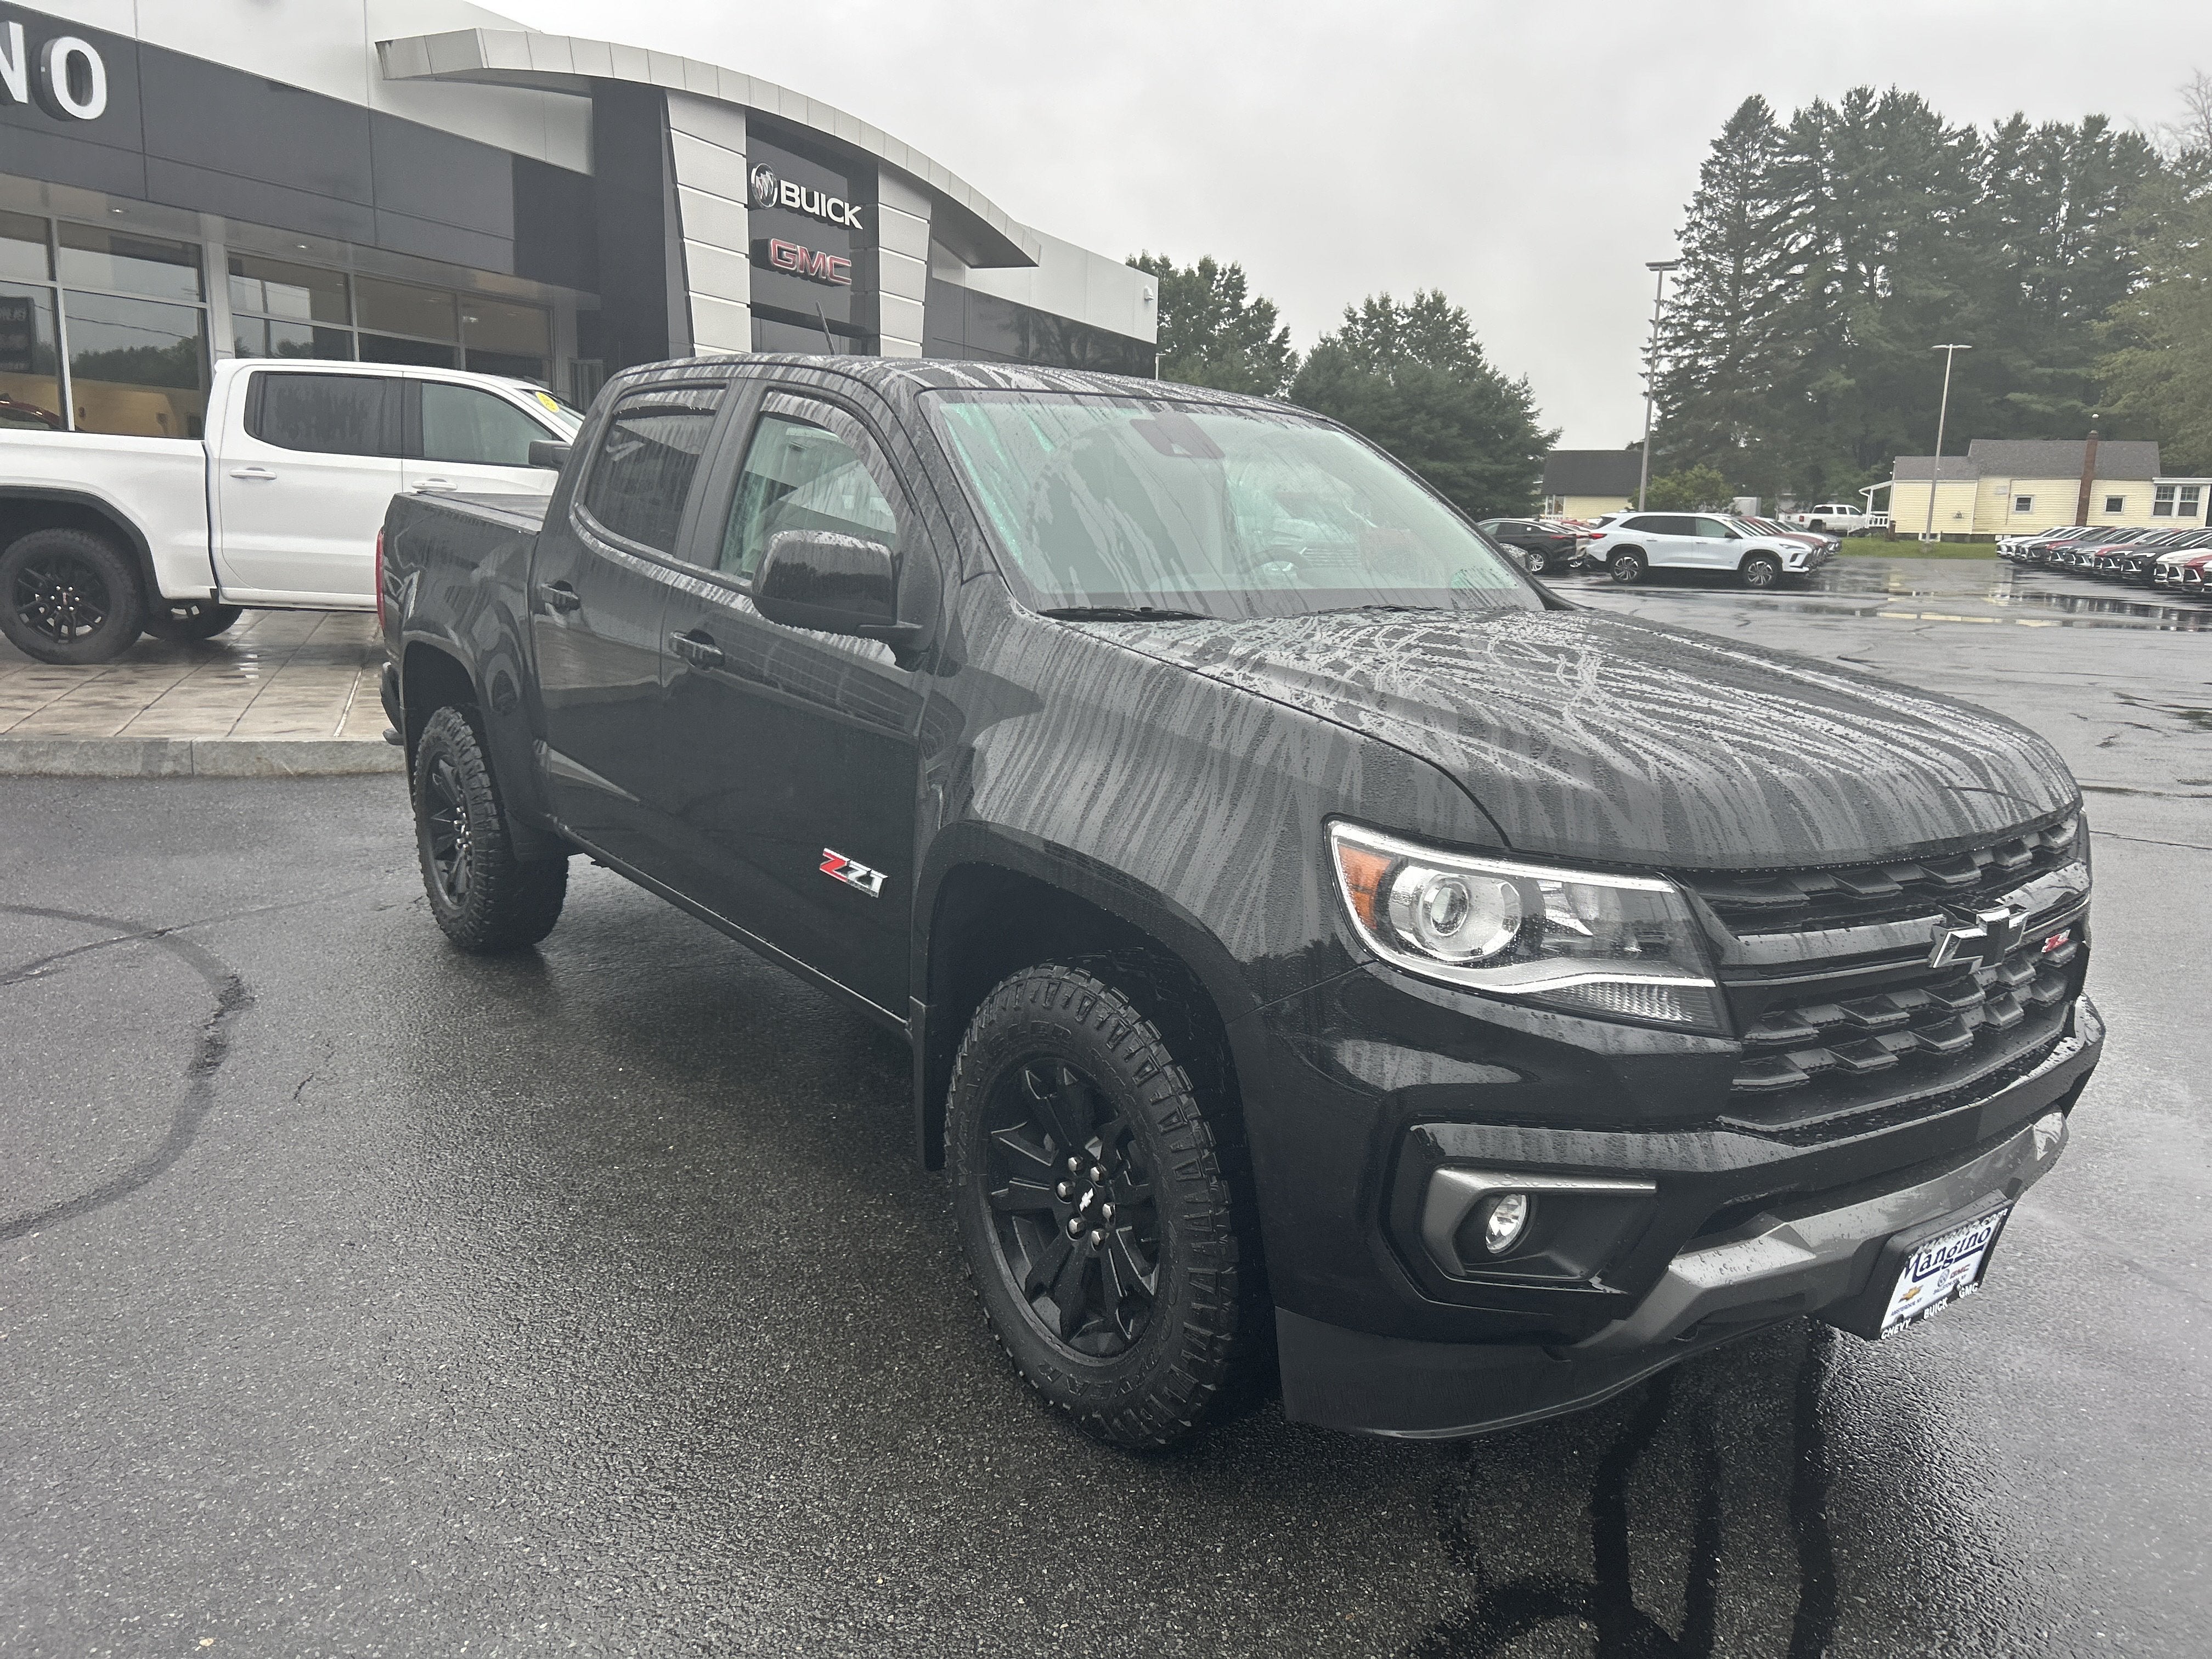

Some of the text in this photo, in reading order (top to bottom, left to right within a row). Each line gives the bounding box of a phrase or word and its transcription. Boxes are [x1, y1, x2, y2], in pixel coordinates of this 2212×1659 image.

[780, 179, 864, 230] BUICK
[770, 238, 852, 285] GMC
[819, 847, 888, 898] Z71
[1904, 1227, 1991, 1283] Mangino
[1881, 1317, 1912, 1340] CHEVY
[1923, 1297, 1949, 1319] BUICK
[1959, 1282, 1979, 1299] GMC
